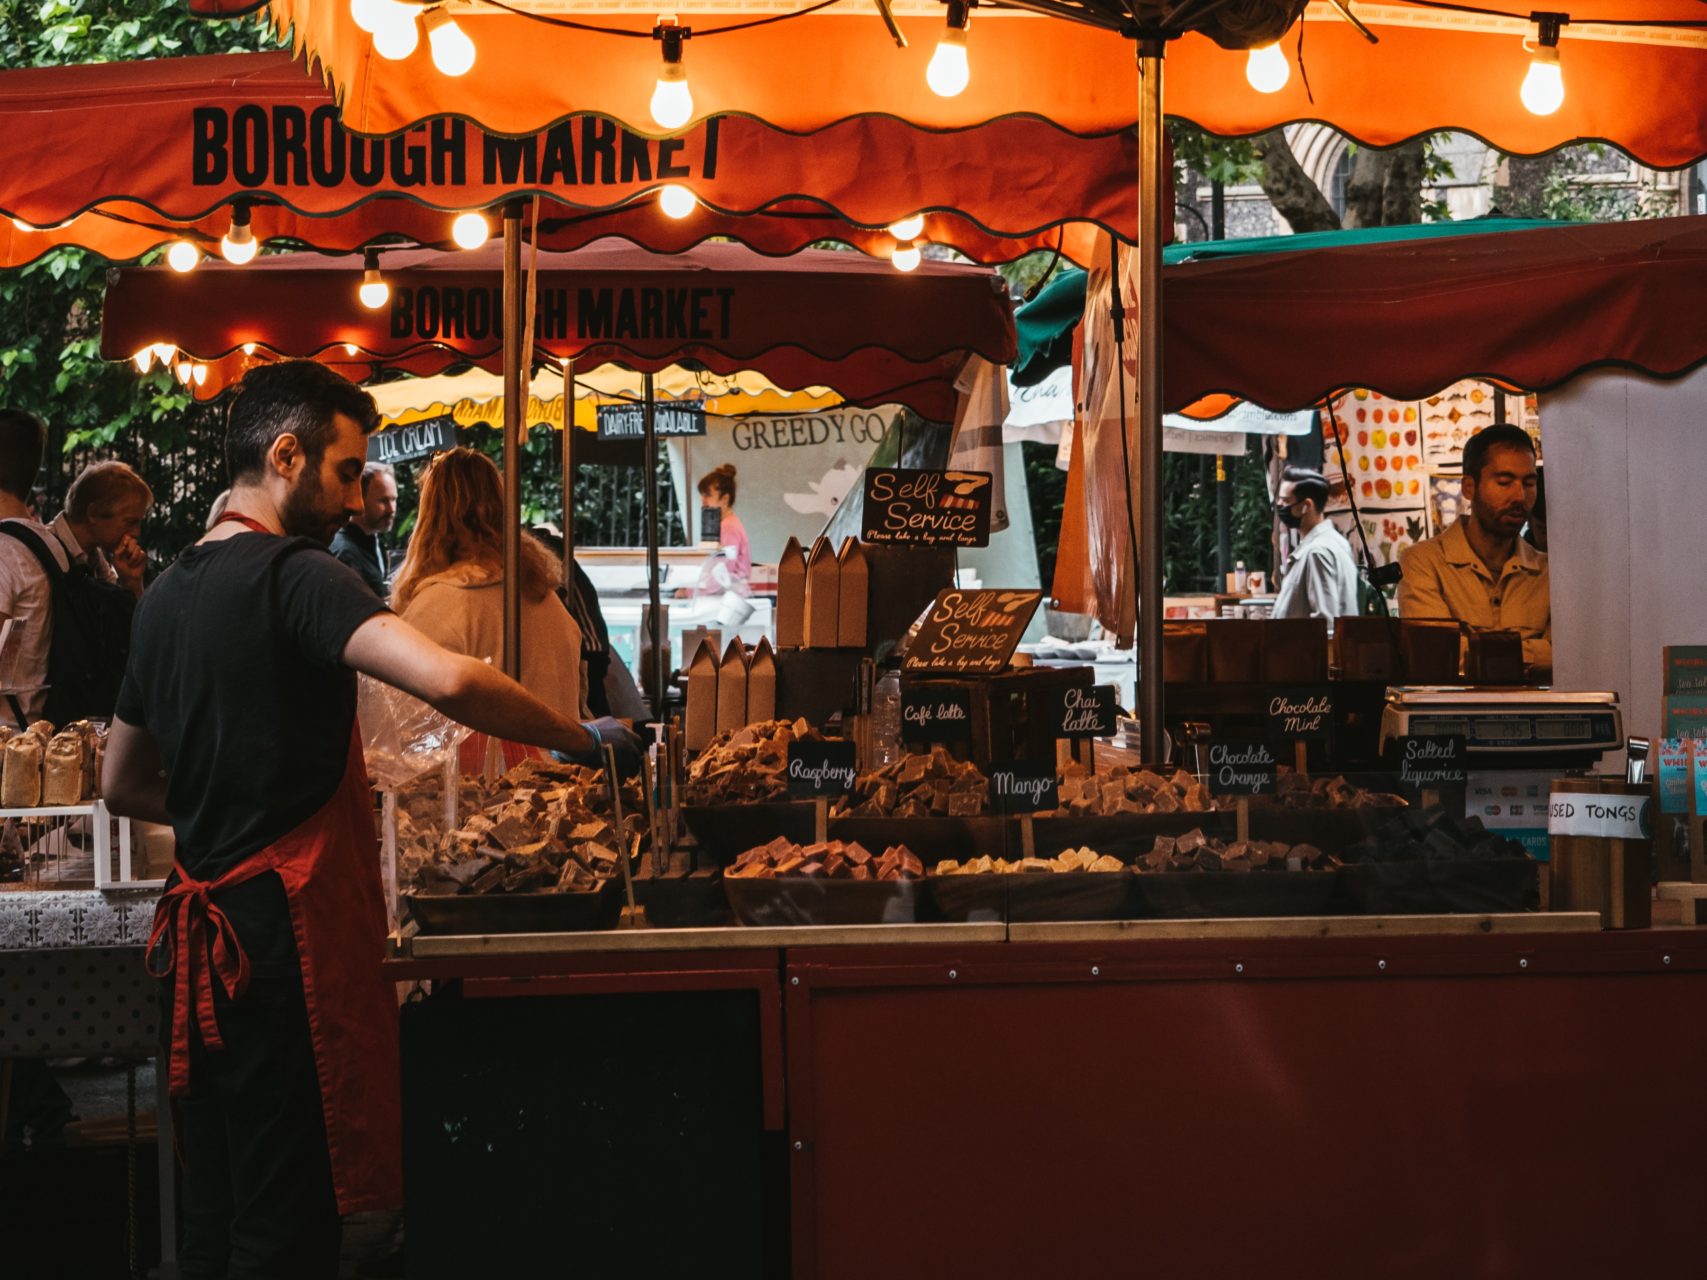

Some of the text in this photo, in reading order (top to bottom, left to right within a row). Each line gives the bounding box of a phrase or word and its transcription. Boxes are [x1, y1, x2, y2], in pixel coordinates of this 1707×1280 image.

[577, 287, 736, 340] MARKET
[603, 411, 646, 436] DAIRY-FRE
[732, 413, 846, 451] GREEDY
[377, 419, 444, 462] ICE CREAM
[870, 472, 941, 510] Self
[883, 501, 977, 532] Service
[866, 529, 892, 540] Please
[895, 530, 911, 540] take
[922, 531, 936, 545] bag
[938, 532, 956, 542] and
[932, 591, 996, 627] Self
[930, 622, 1009, 654] Service
[906, 656, 929, 668] Please
[956, 655, 967, 671] bag
[968, 656, 985, 667] and
[1064, 688, 1102, 709] Chai
[1269, 695, 1332, 716] Chocolate
[904, 703, 967, 727] Café latte
[1061, 709, 1106, 733] latte
[1284, 714, 1322, 733] Mint
[1209, 743, 1276, 765] Chocolate
[1405, 737, 1456, 760] Salted
[789, 758, 857, 790] Raspberry
[1218, 764, 1271, 794] Orange
[1400, 758, 1464, 788] liquorice
[993, 771, 1055, 806] Mango
[1585, 804, 1636, 822] TONGS
